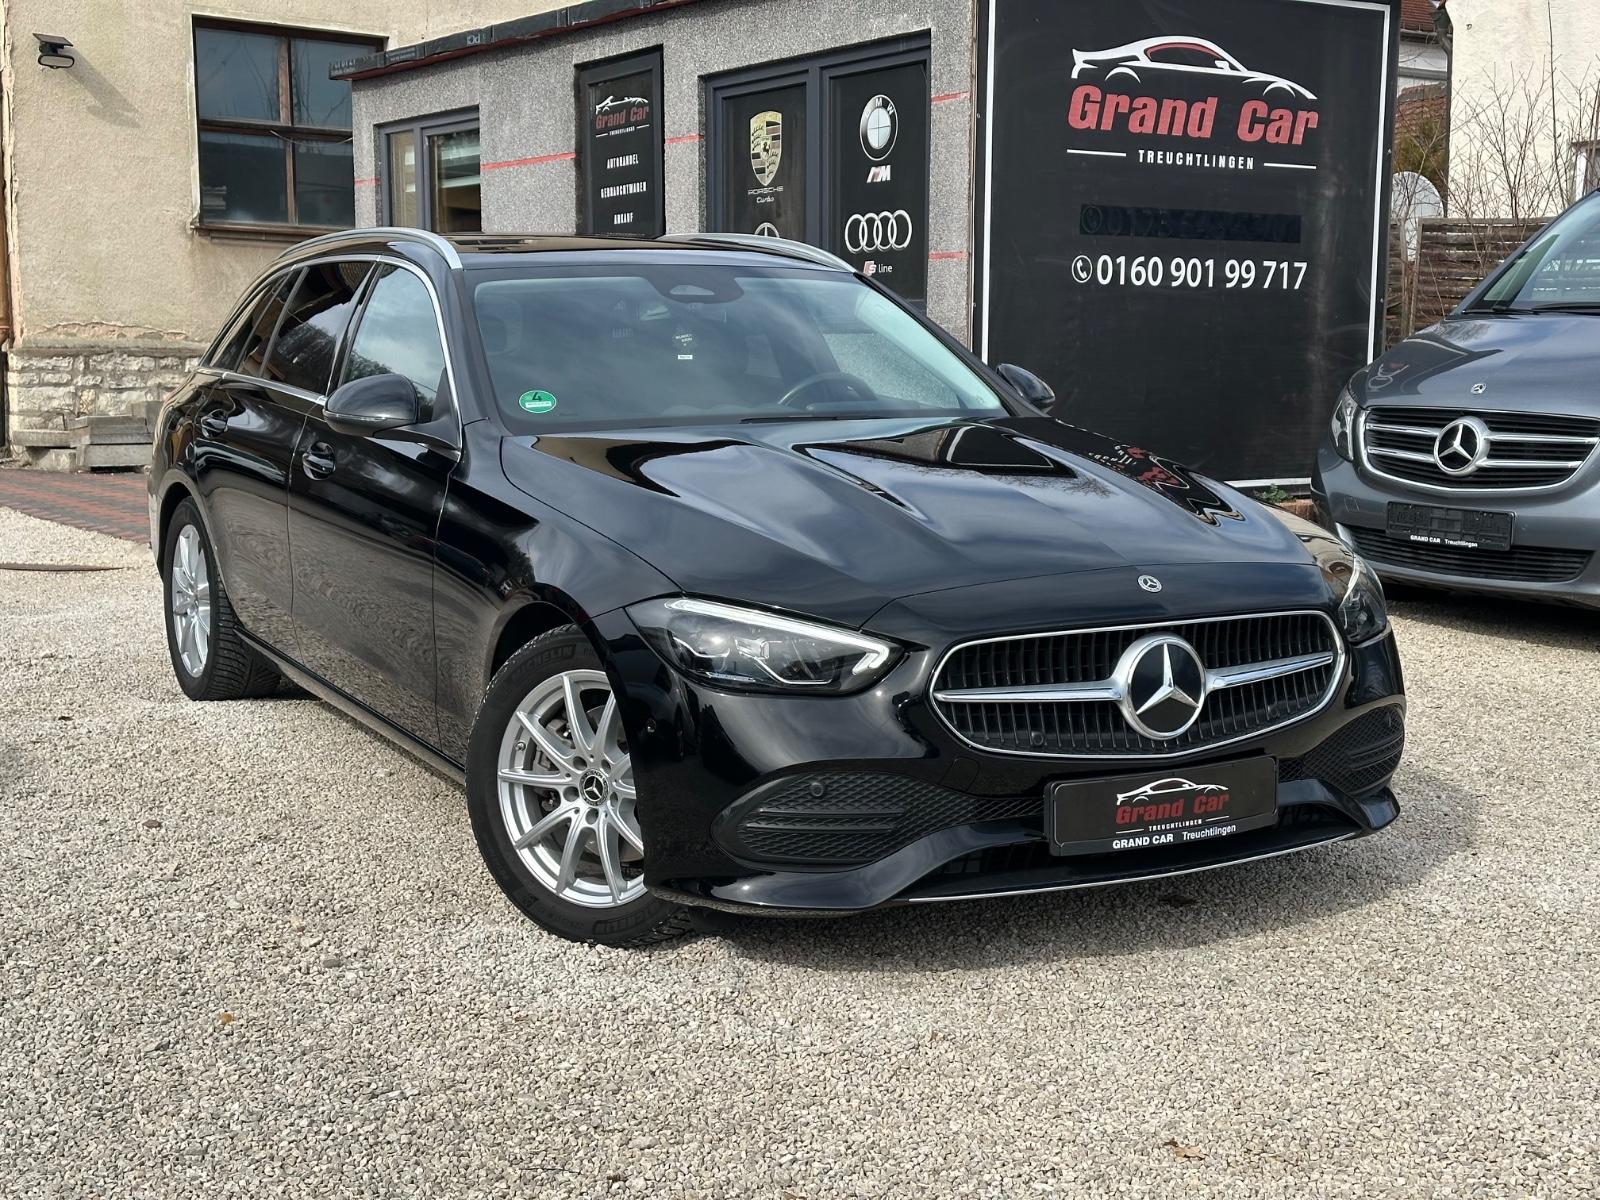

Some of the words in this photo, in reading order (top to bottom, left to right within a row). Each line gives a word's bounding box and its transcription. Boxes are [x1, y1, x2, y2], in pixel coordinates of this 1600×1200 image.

[595, 109, 626, 129] Grand
[630, 106, 649, 121] Car
[1067, 84, 1218, 138] Grand
[1237, 99, 1318, 145] Car
[607, 154, 638, 169] AUTOHANDEL
[1138, 150, 1254, 170] TREUCHTLINGEN
[747, 185, 784, 195] PORSCHE
[878, 263, 893, 273] line
[1096, 254, 1164, 287] 0160
[1170, 256, 1215, 288] 901
[1224, 259, 1256, 289] 99
[1262, 260, 1308, 290] 717
[531, 391, 543, 402] 4
[1410, 534, 1429, 542] GRAND
[1115, 798, 1185, 825] Grand
[1193, 793, 1230, 814] Car
[1148, 819, 1202, 832] TREUCHTLINGEN
[1112, 836, 1150, 850] GRAND
[1152, 833, 1174, 845] CAR
[1182, 824, 1237, 841] Treuchtlingen
